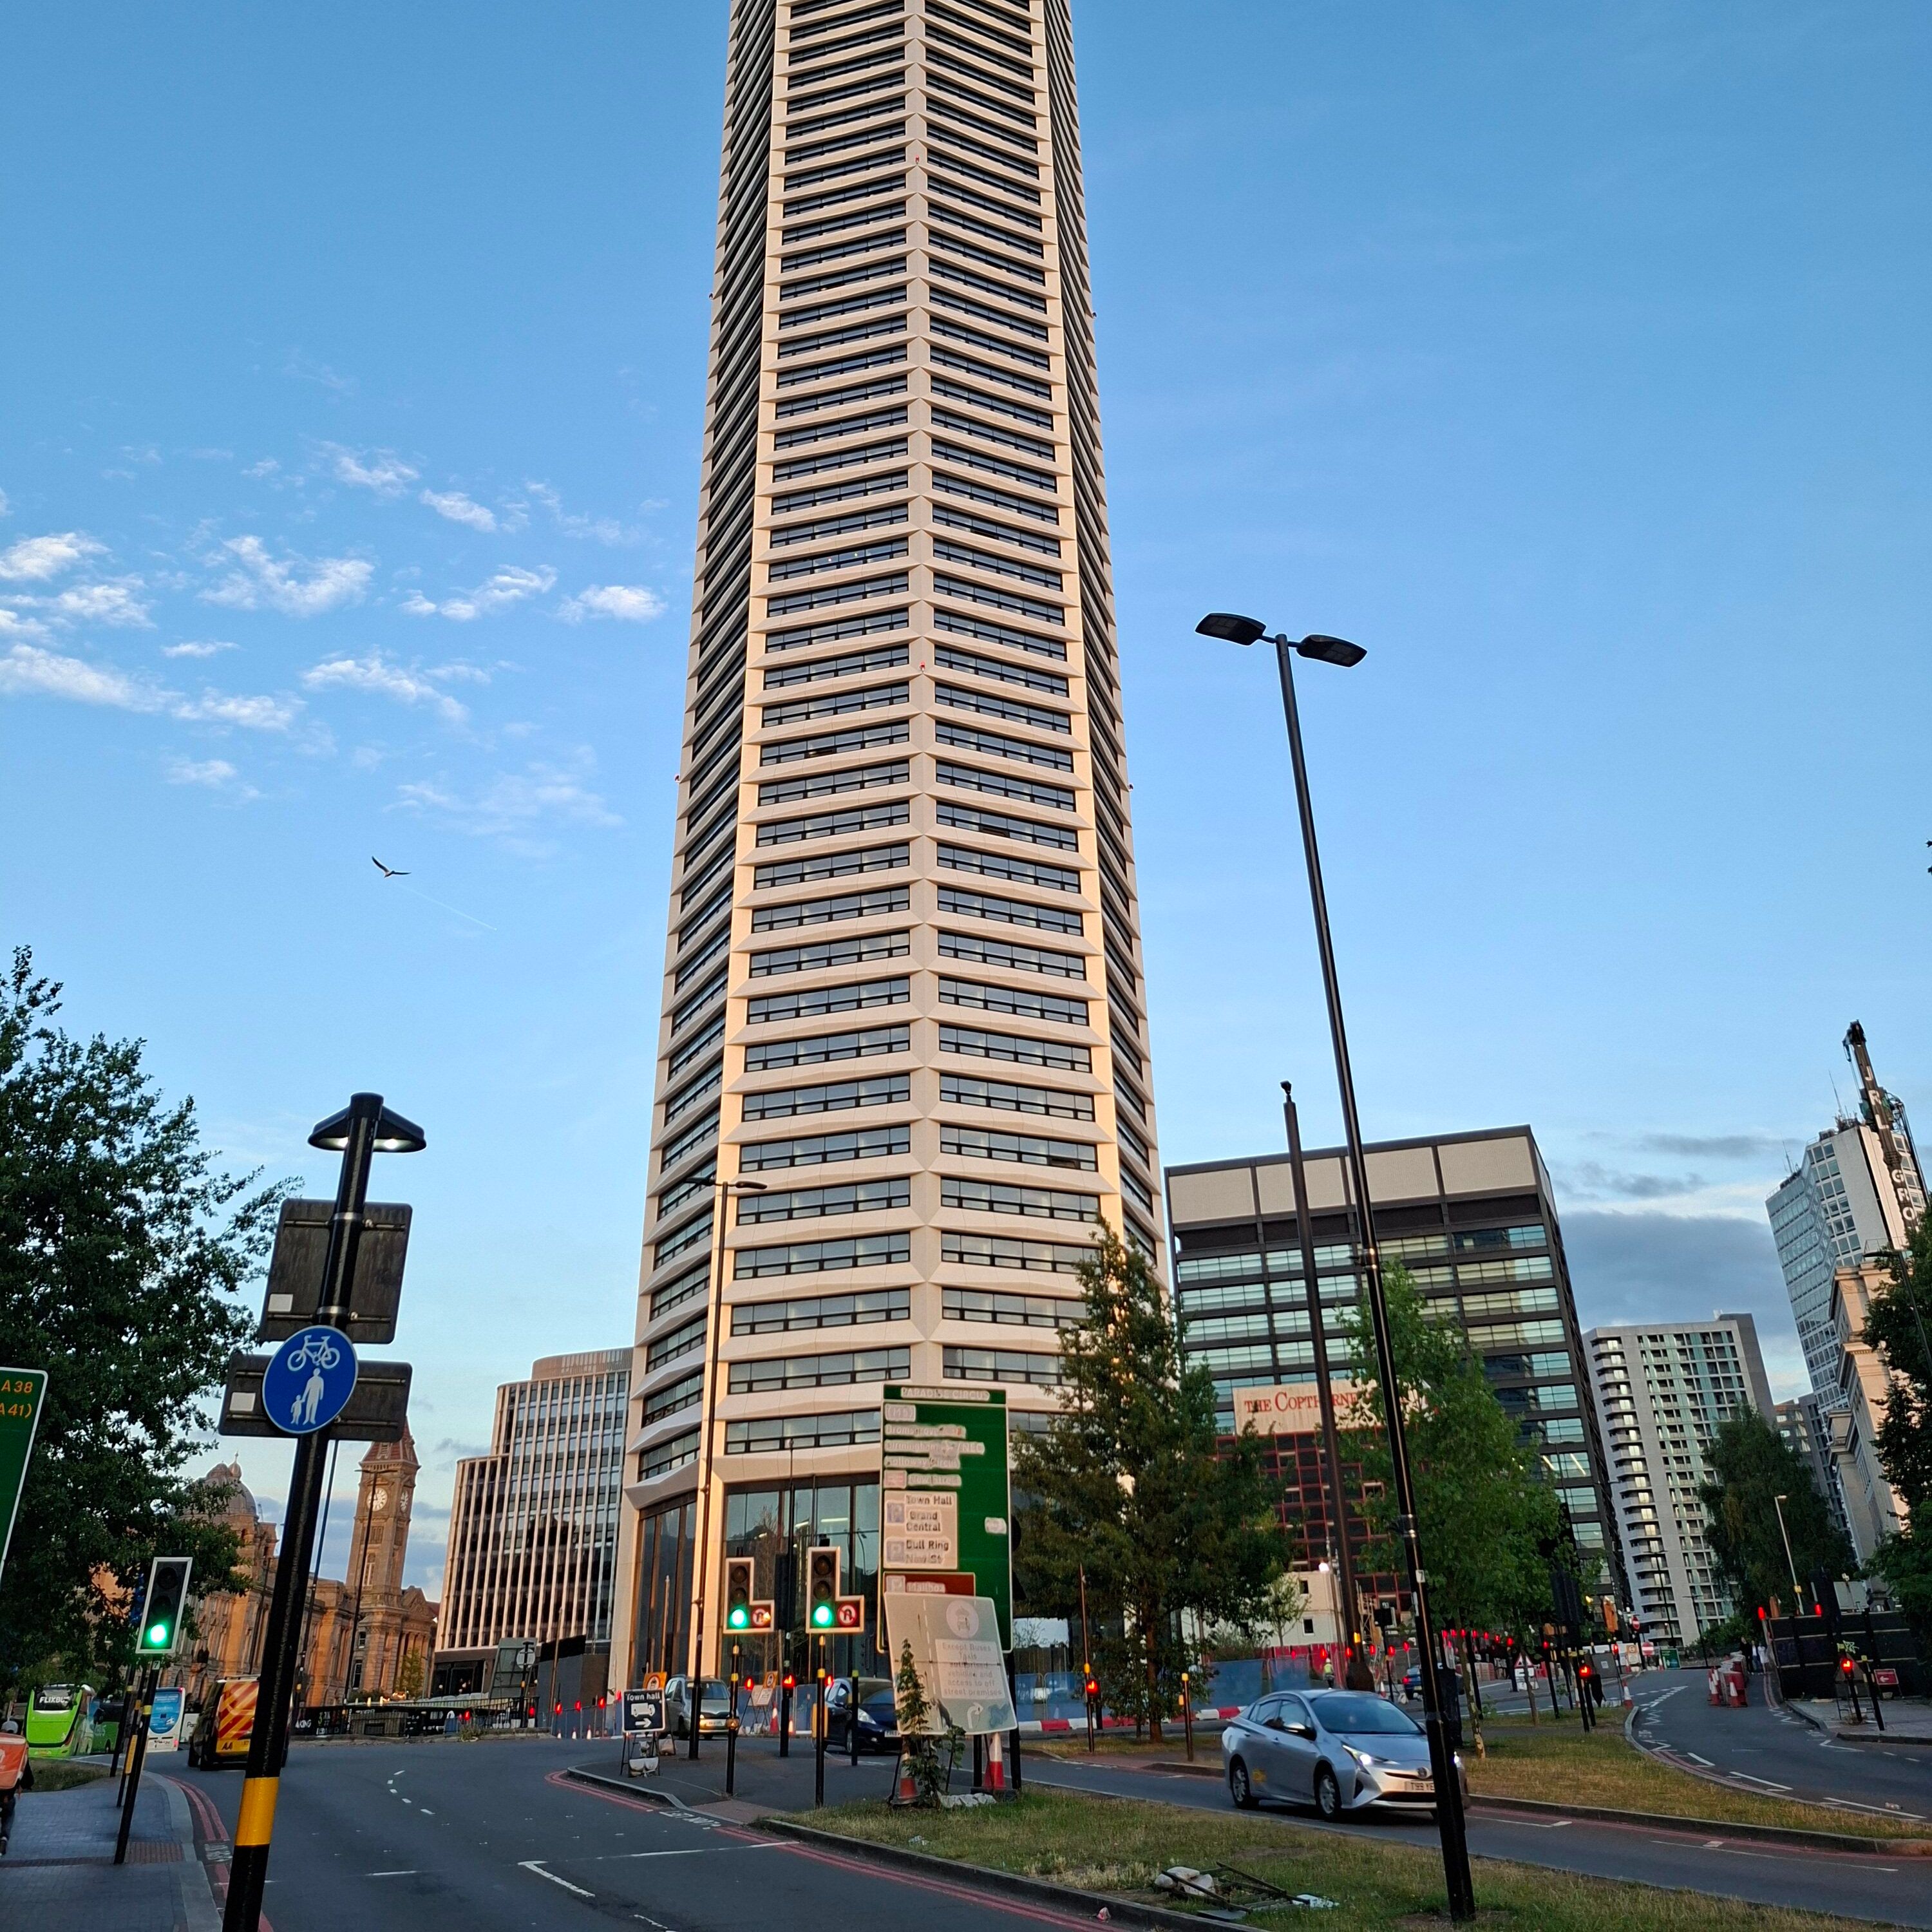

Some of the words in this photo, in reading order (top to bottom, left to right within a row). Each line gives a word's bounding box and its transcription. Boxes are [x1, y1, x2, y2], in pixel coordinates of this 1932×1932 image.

[1, 1379, 33, 1393] A38
[902, 1387, 949, 1399] PARADISE
[952, 1389, 990, 1400] CIRCUS
[1244, 1399, 1272, 1414] THE
[905, 1495, 930, 1505] Town
[933, 1495, 952, 1505] Hall
[909, 1511, 938, 1520] Grand
[906, 1522, 941, 1532] Central
[928, 1540, 949, 1551] Ring
[942, 1642, 967, 1651] Except
[969, 1643, 991, 1651] Buses
[960, 1651, 977, 1660] Taxis
[646, 1692, 661, 1700] hall
[969, 1689, 1002, 1697] premises
